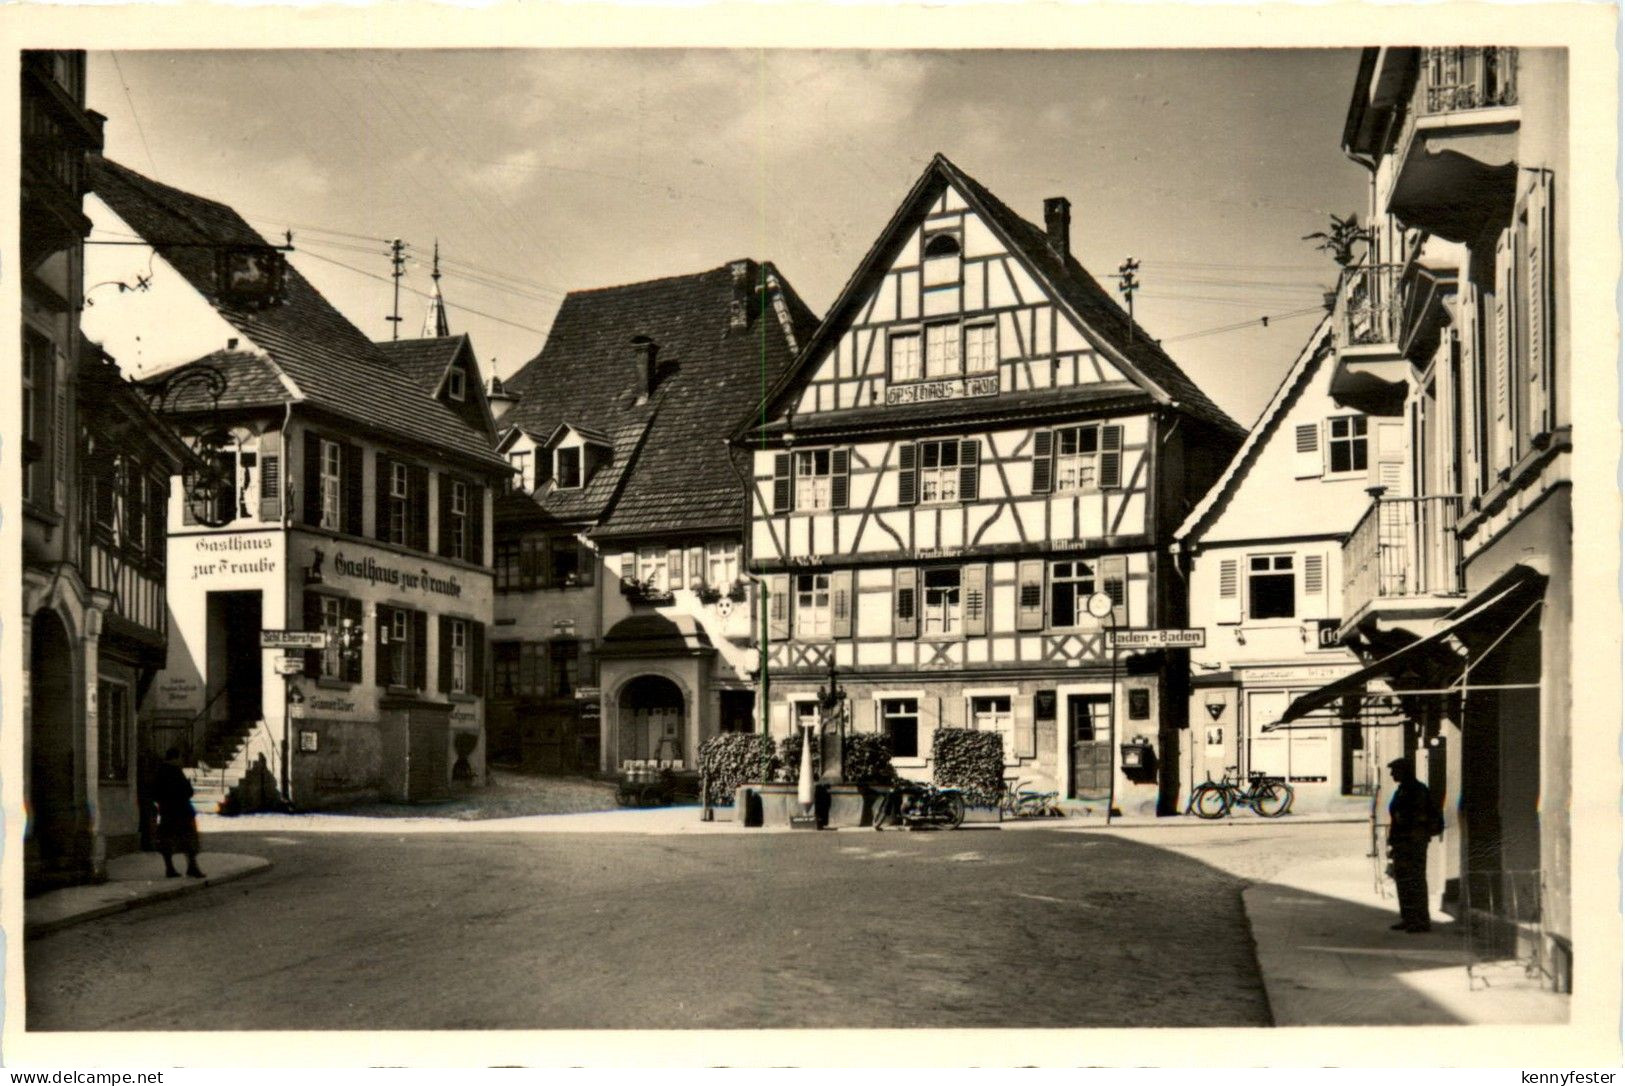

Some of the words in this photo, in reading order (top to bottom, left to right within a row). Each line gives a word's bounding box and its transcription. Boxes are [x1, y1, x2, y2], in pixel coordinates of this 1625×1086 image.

[196, 536, 272, 552] Gasthaus
[191, 564, 216, 579] zur
[219, 557, 276, 573] Traube
[335, 552, 399, 586] Gasthaus
[400, 573, 419, 592] zur
[421, 568, 461, 598] Traube
